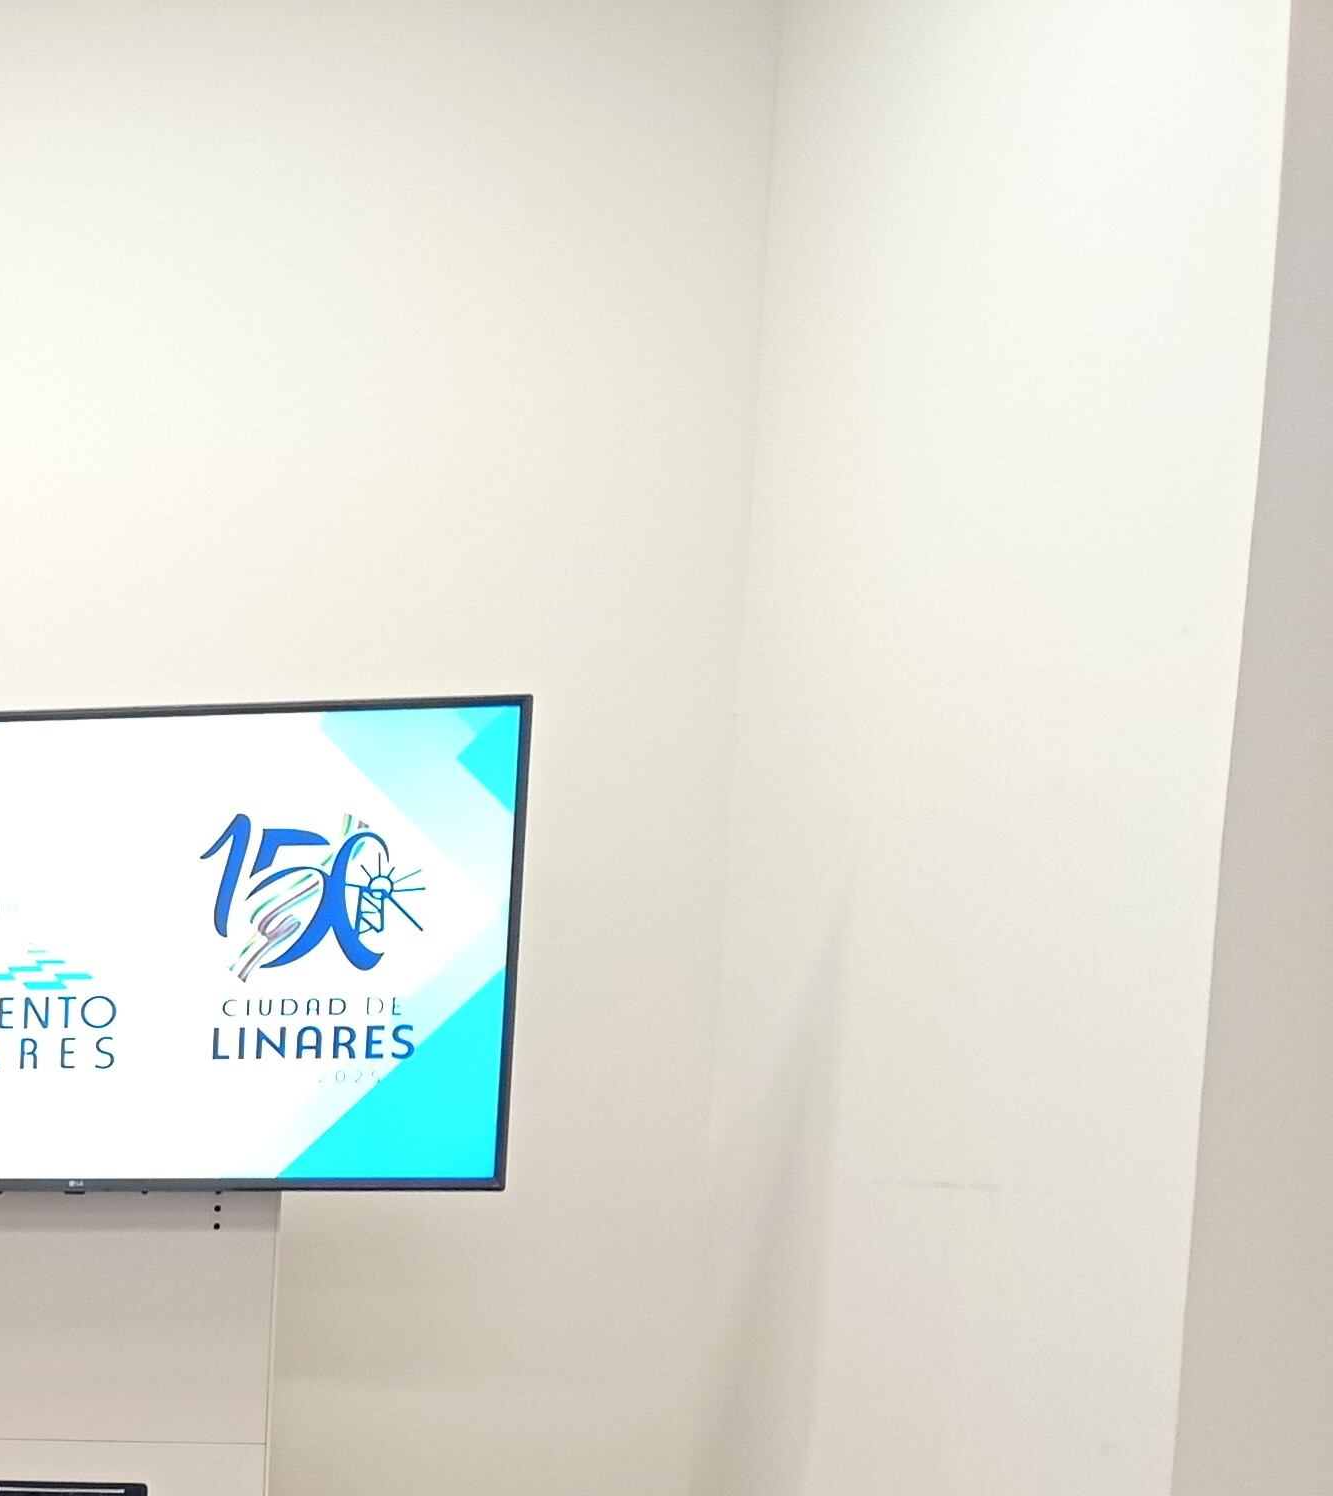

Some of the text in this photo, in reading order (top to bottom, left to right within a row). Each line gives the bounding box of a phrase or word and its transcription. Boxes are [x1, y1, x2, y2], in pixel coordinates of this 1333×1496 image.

[222, 996, 403, 1017] CIUDAD DE
[212, 1024, 415, 1060] LINARES
